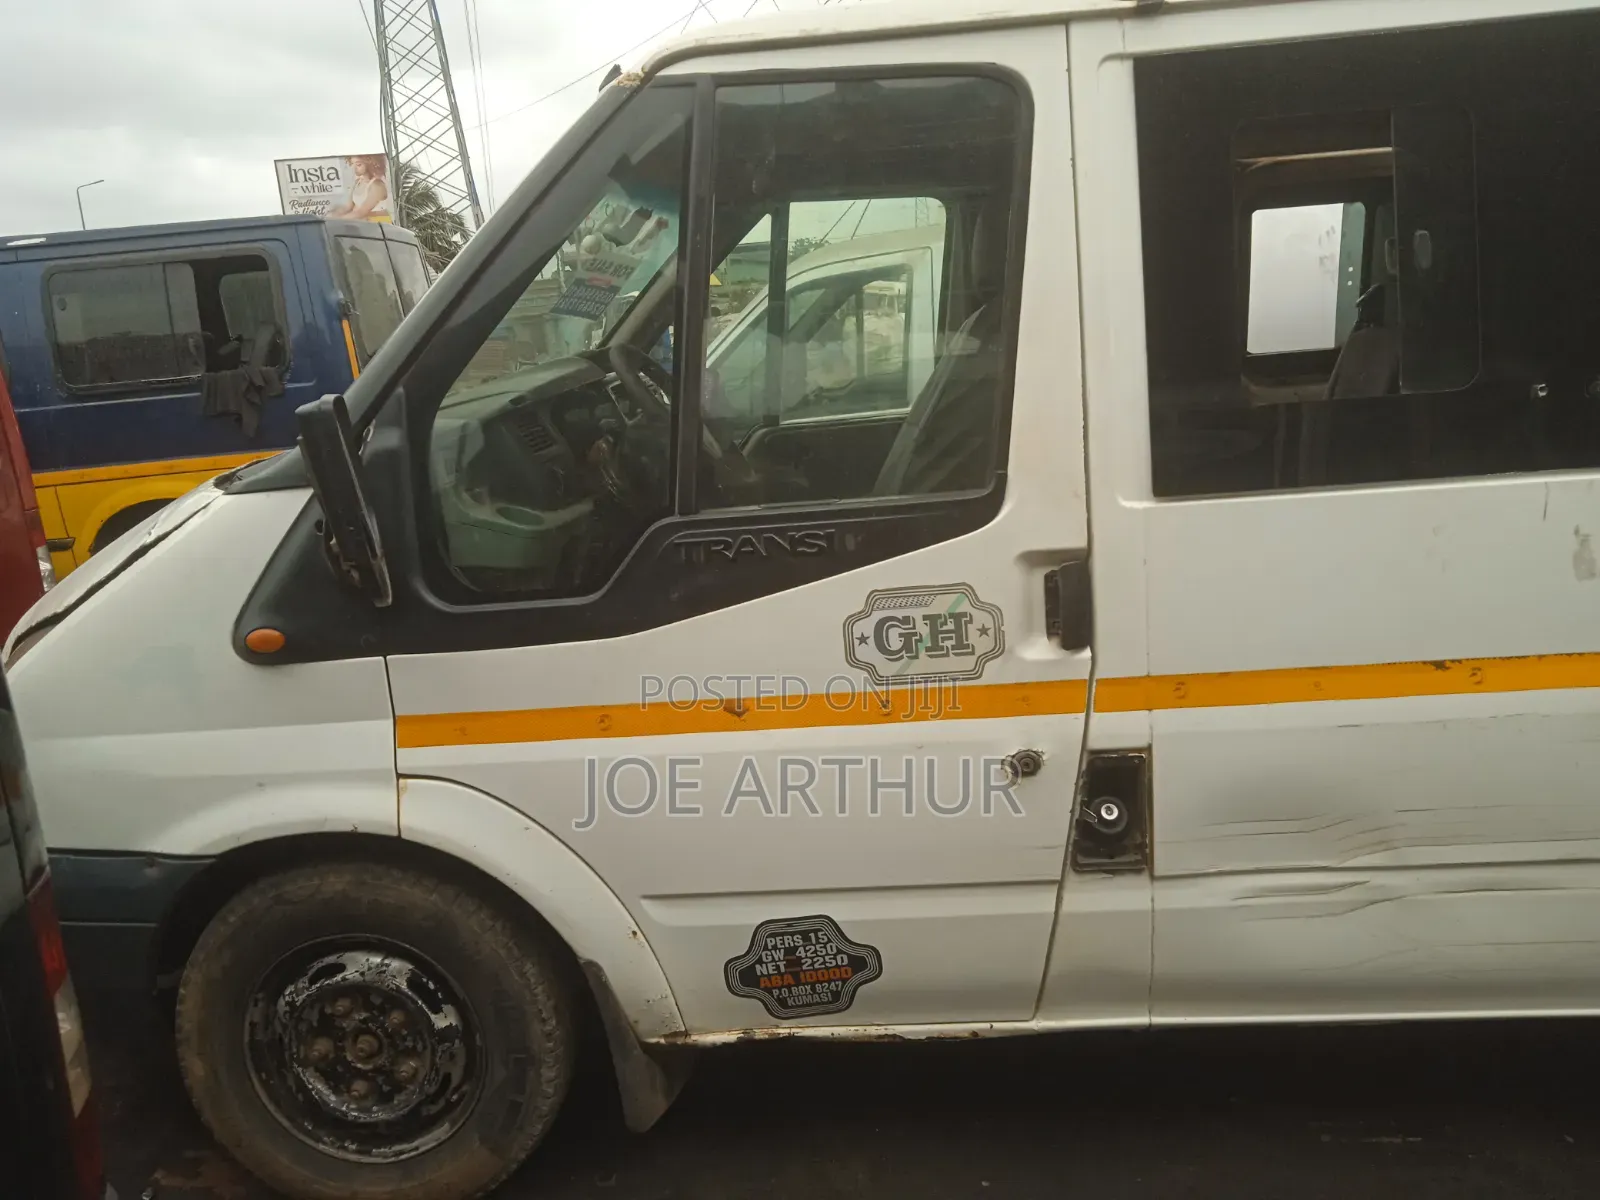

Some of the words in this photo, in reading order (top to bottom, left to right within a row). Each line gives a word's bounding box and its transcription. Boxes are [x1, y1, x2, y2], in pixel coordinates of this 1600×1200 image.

[286, 163, 340, 183] Insta
[300, 182, 333, 193] white
[289, 199, 330, 210] Radiance
[873, 611, 976, 661] GH
[766, 935, 803, 949] PERS
[808, 931, 828, 944] 15
[761, 949, 785, 962] GW
[796, 943, 837, 958] 4250
[755, 961, 786, 976] NET
[801, 954, 849, 970] 2250
[760, 974, 796, 988] ABA
[815, 980, 842, 993] 8247
[787, 992, 832, 1007] KUMASI
